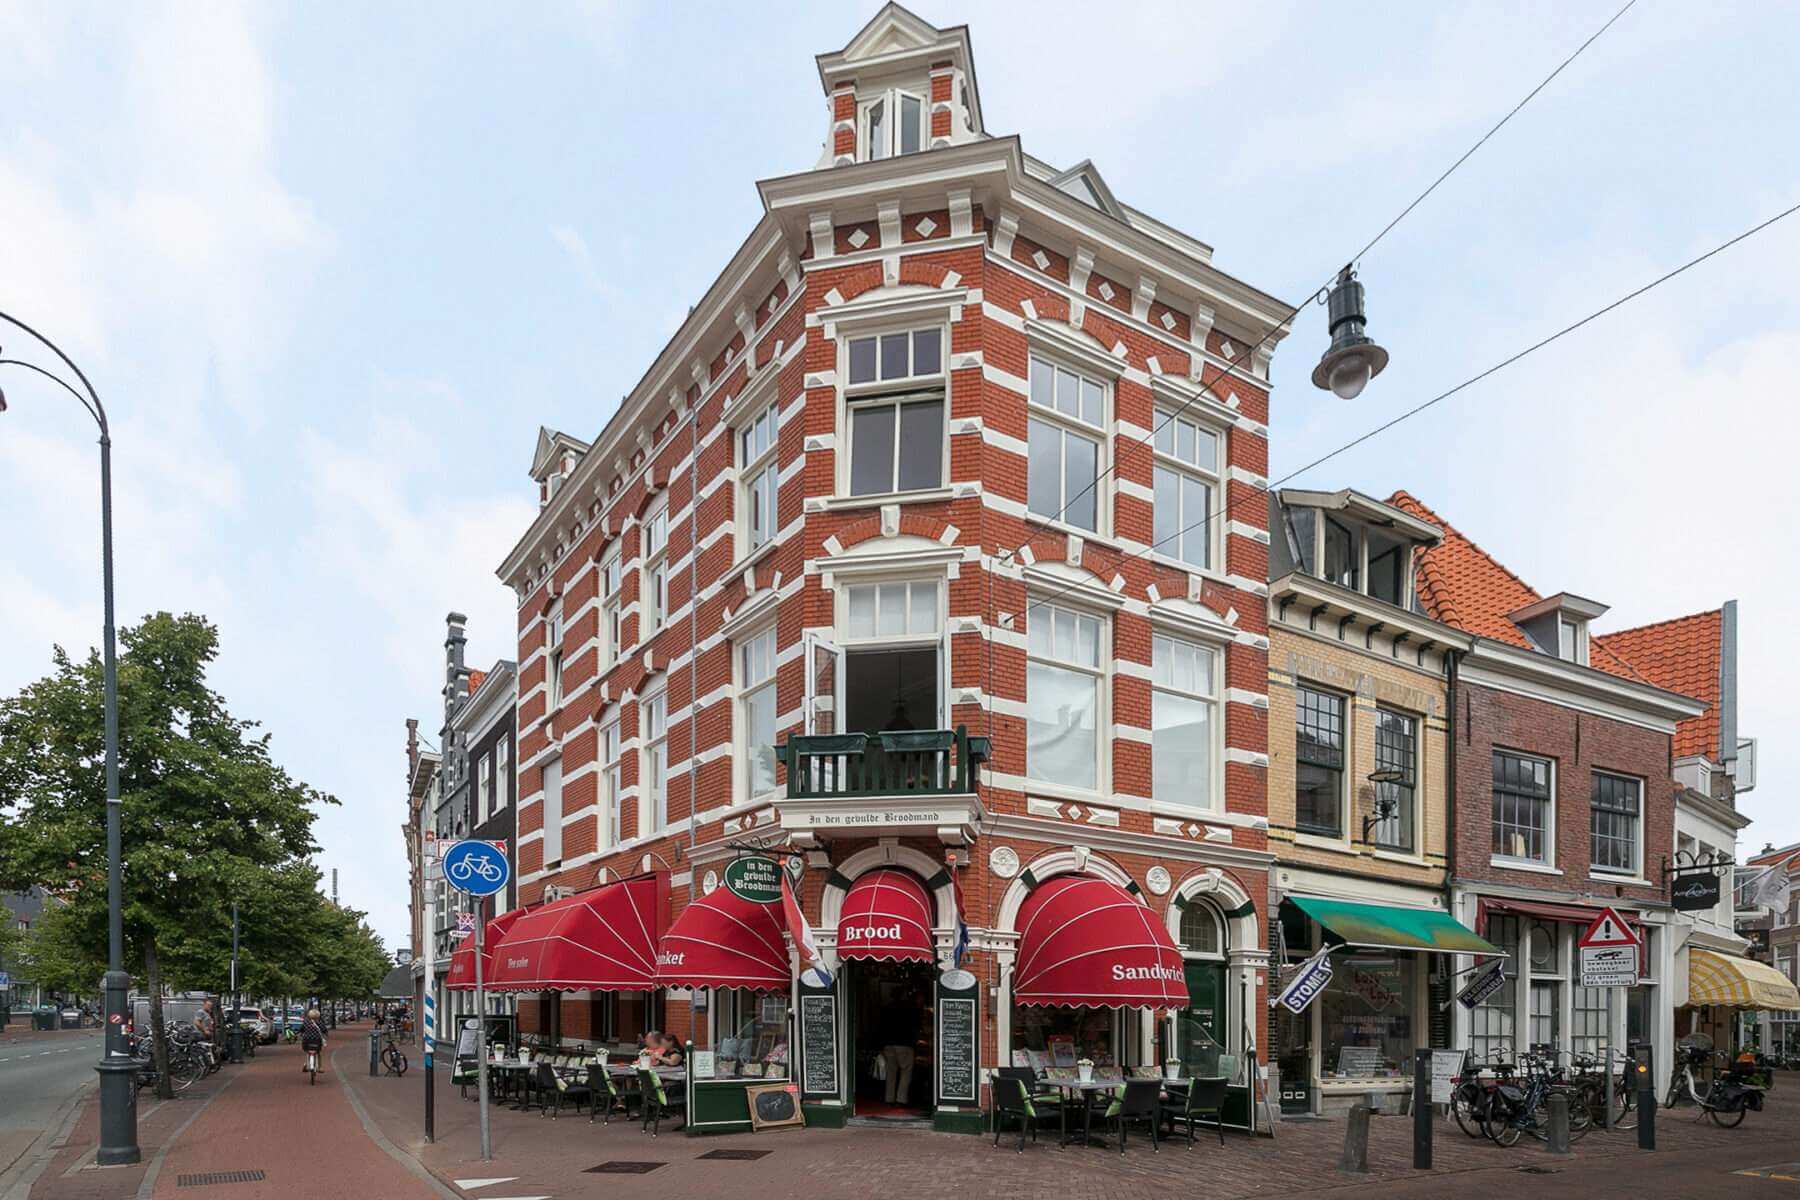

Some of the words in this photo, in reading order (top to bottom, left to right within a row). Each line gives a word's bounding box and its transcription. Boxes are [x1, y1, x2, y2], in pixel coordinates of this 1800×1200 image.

[808, 815, 821, 824] In
[825, 815, 841, 823] den
[844, 813, 880, 825] gevulde
[884, 812, 940, 823] Broodmand
[746, 862, 756, 871] in
[757, 862, 773, 871] den
[743, 872, 776, 882] gevulde
[845, 923, 902, 941] Brood
